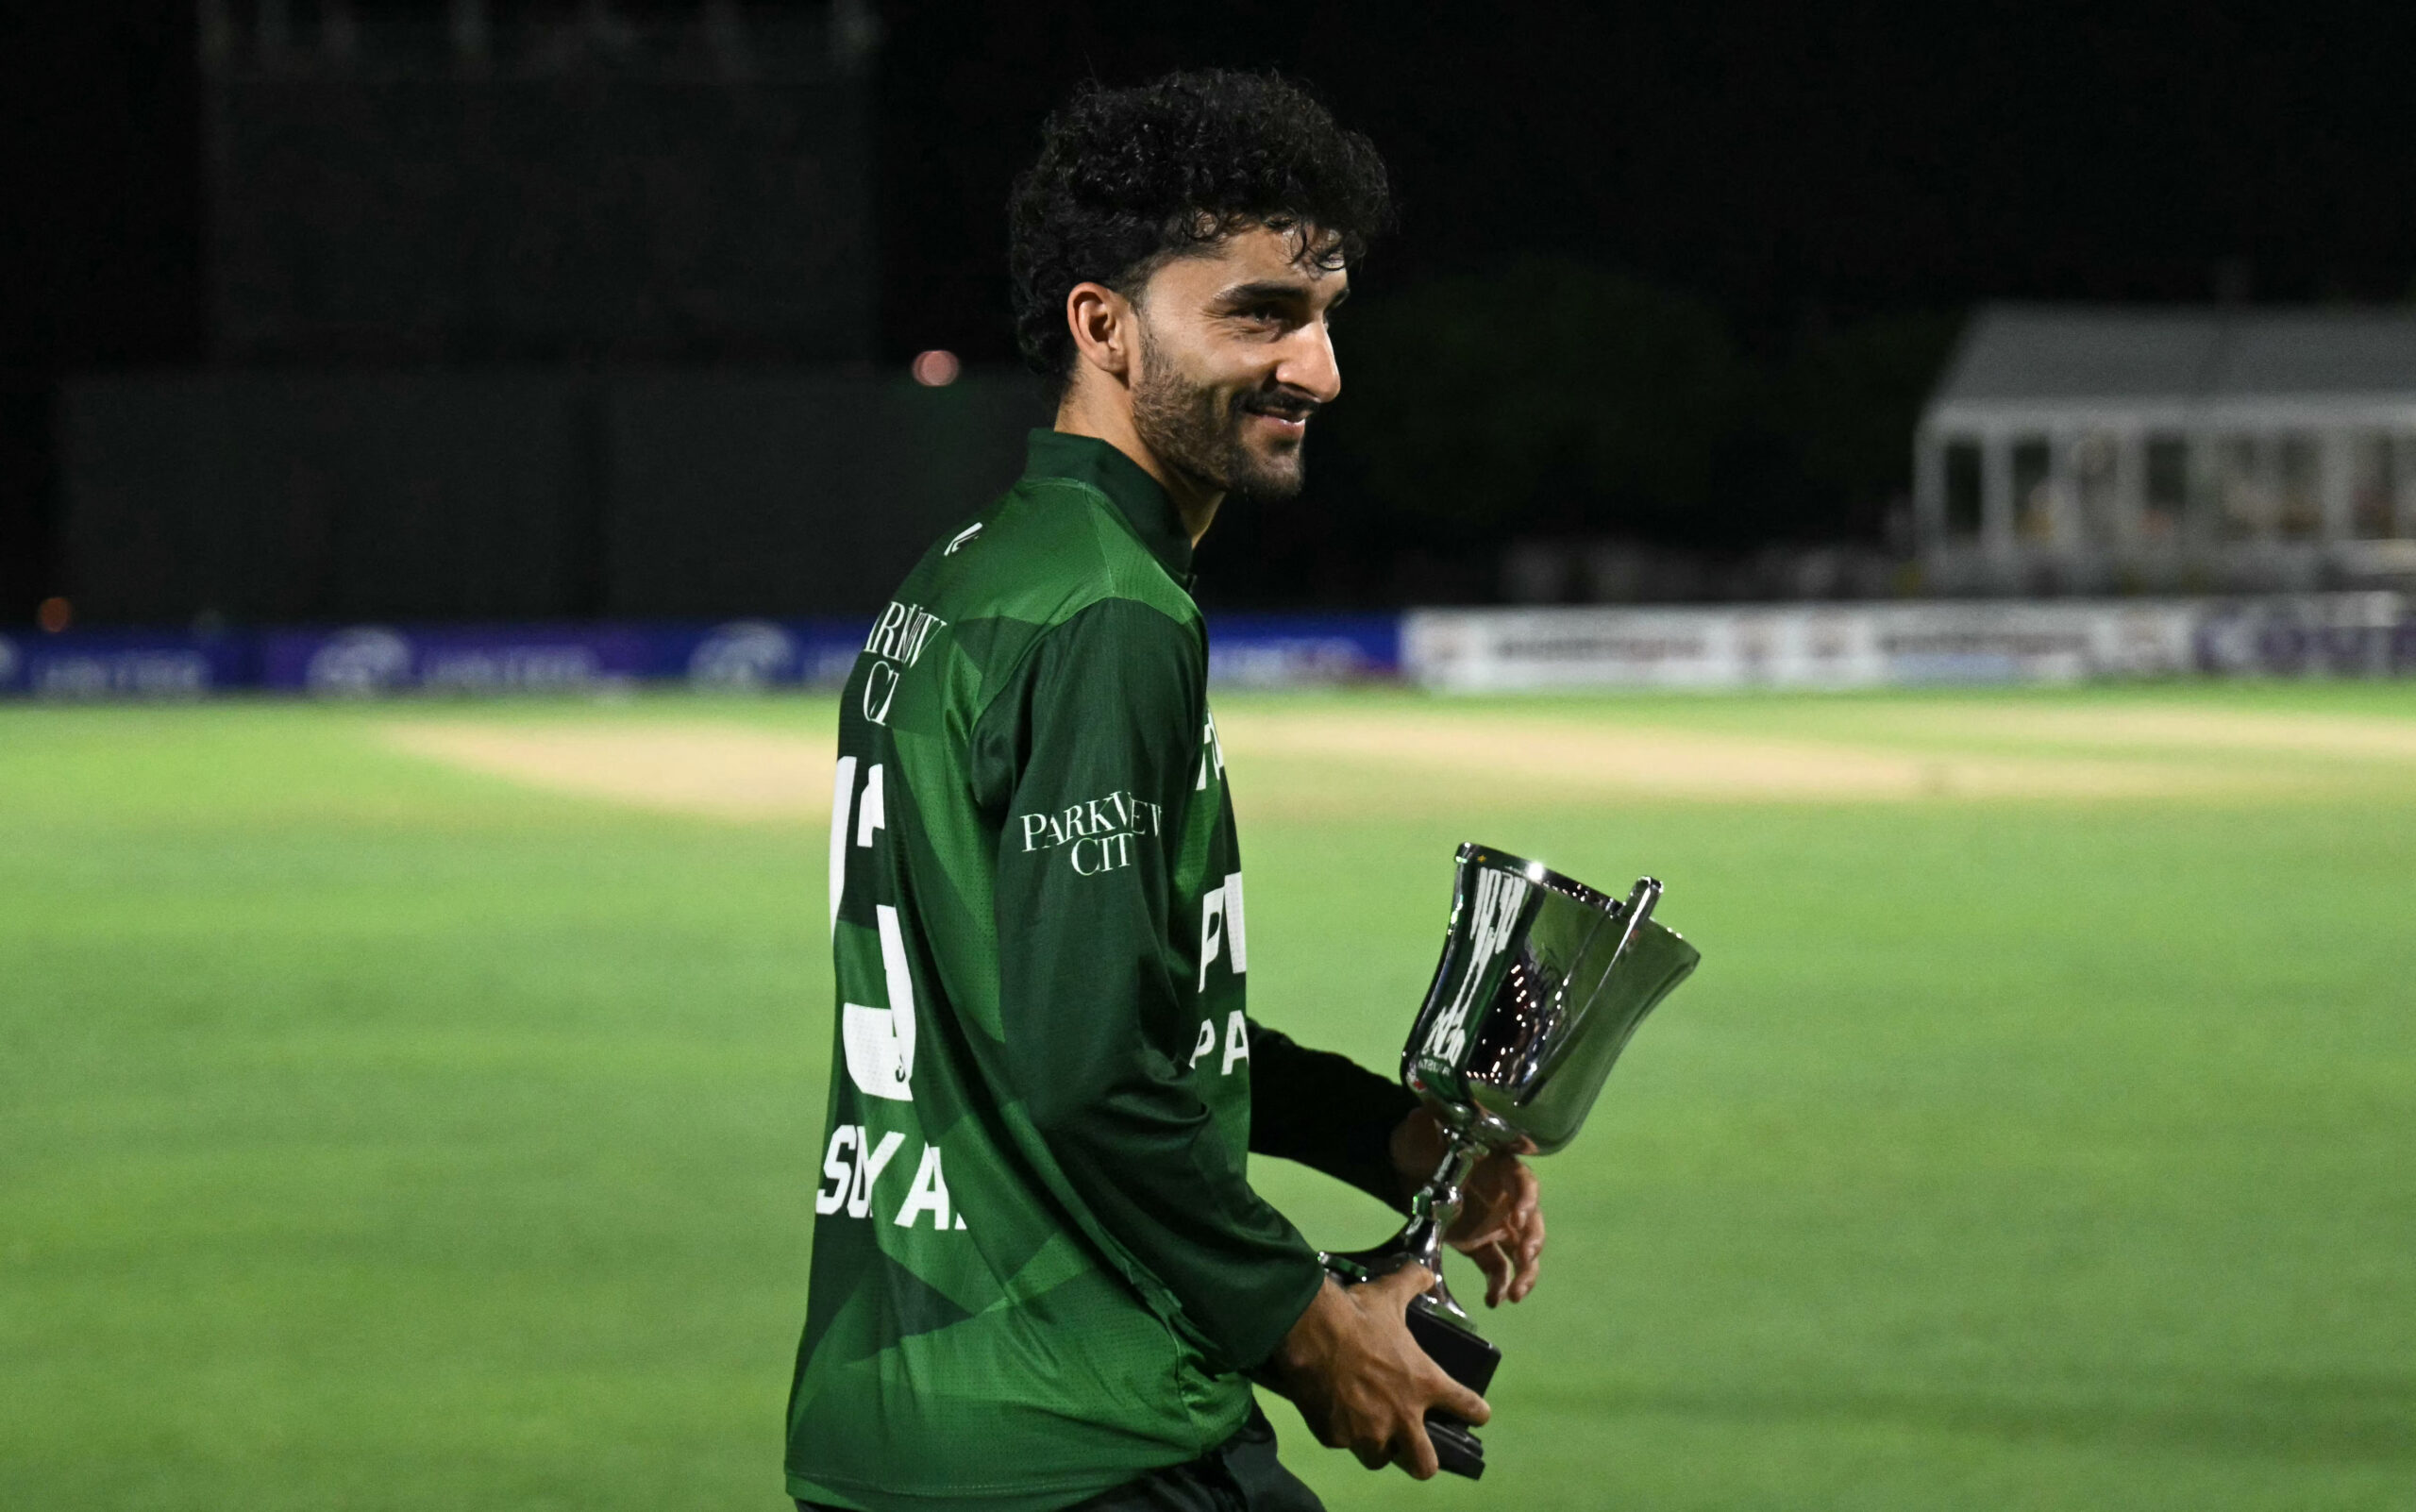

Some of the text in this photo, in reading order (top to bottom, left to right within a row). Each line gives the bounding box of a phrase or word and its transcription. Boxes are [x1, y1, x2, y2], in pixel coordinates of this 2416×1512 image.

[1019, 790, 1163, 853] PARKVE
[1070, 832, 1133, 877] CIT
[815, 1124, 967, 1231] SUYA
